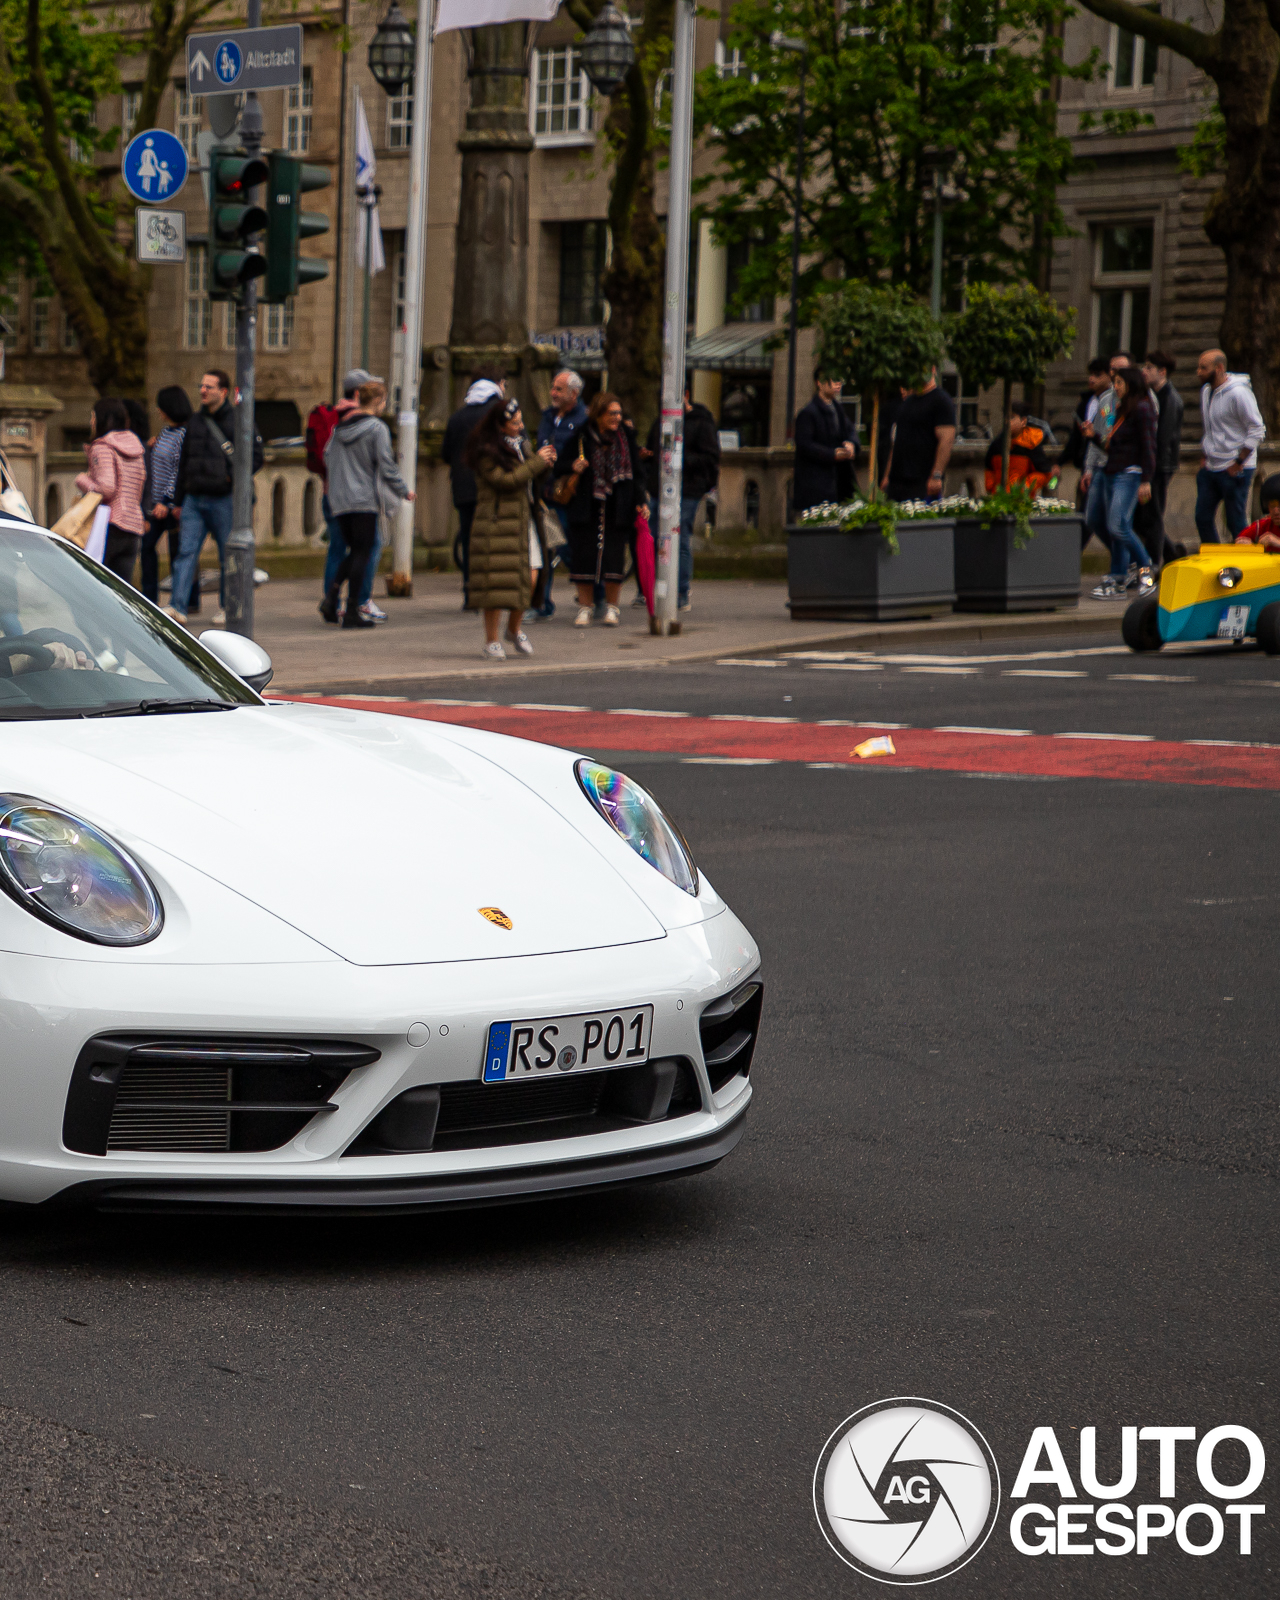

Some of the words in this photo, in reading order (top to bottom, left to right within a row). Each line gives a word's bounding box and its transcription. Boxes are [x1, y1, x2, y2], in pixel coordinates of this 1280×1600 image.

[246, 47, 296, 69] Altstadt
[509, 1024, 559, 1072] RS
[492, 1058, 501, 1071] D
